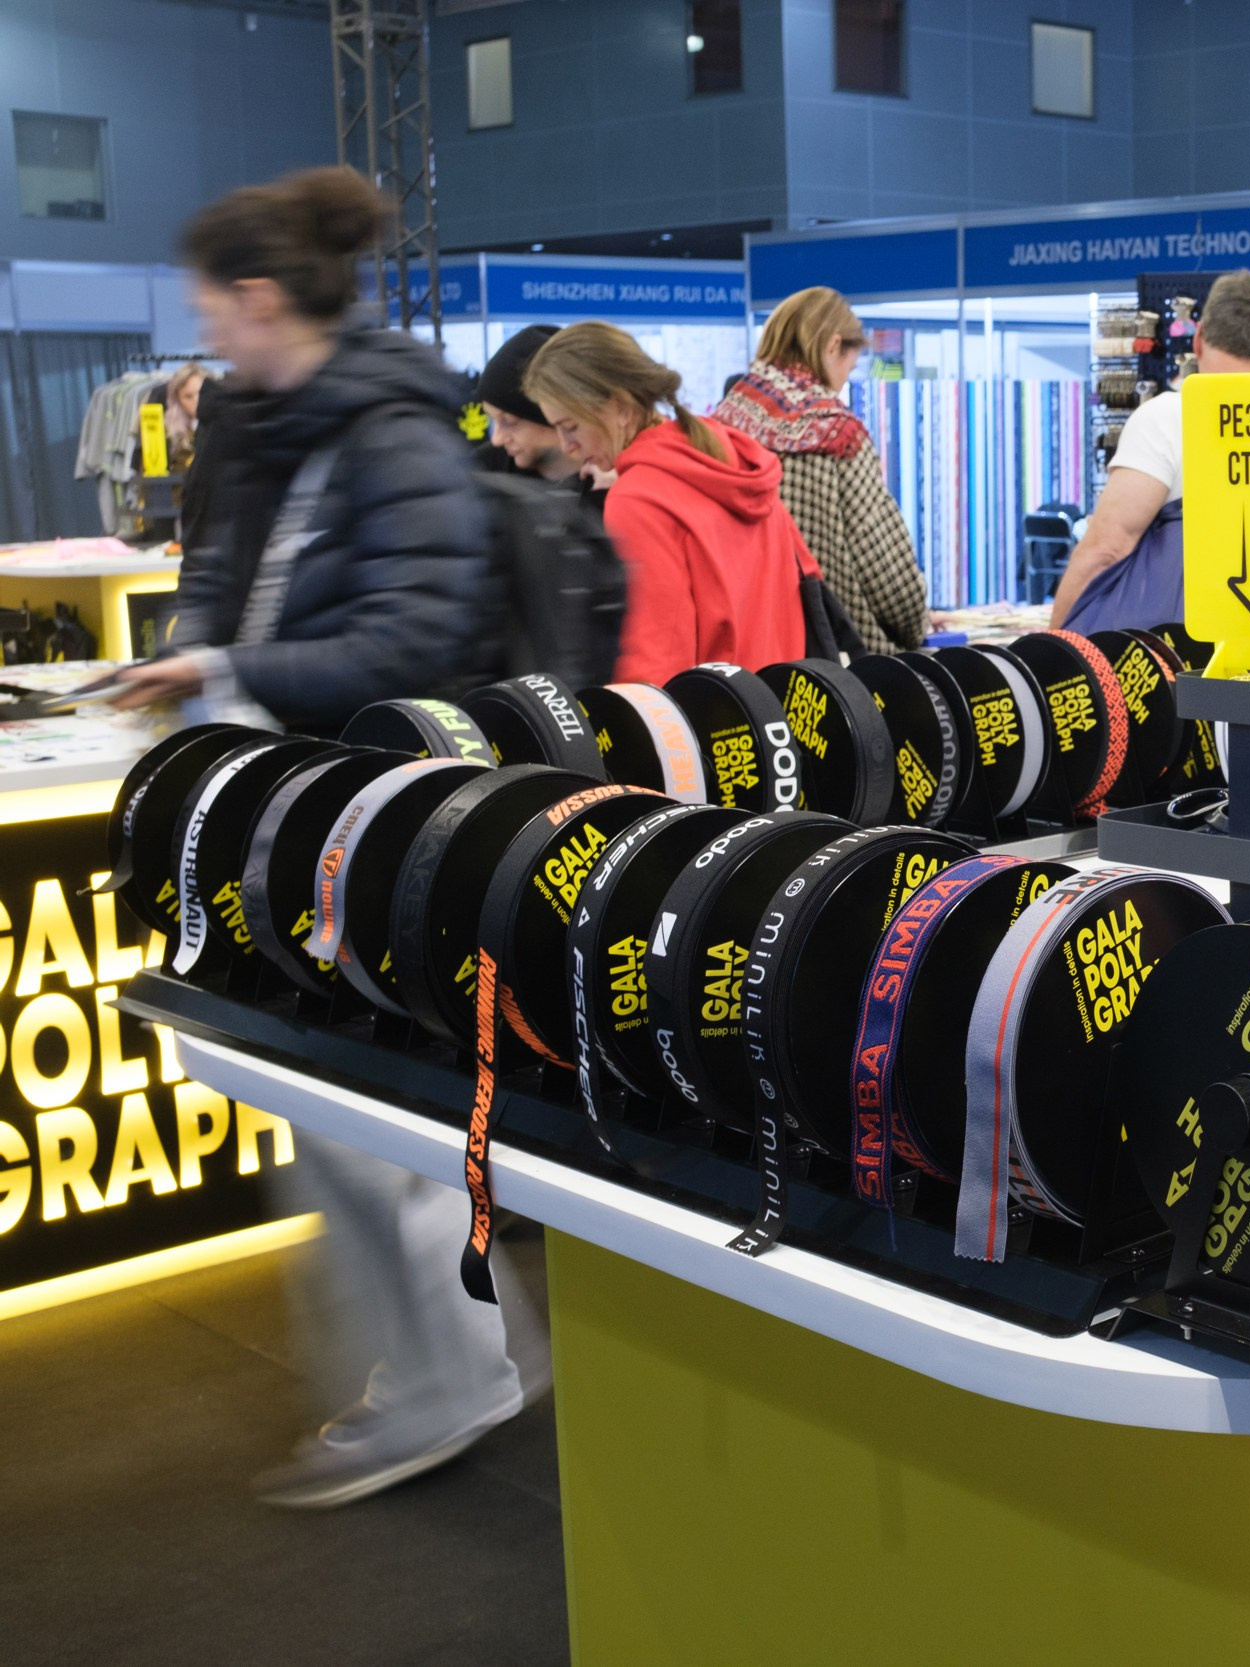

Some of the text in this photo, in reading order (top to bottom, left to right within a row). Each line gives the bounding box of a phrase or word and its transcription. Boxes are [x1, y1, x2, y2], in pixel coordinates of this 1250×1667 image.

[1009, 240, 1082, 267] JIAXING
[1087, 236, 1159, 261] HAIYAN
[521, 281, 615, 302] SHENZHEN
[619, 284, 670, 303] XIANG
[673, 285, 701, 303] RUI
[704, 286, 727, 304] DA
[795, 675, 827, 716] GALA
[1130, 648, 1160, 691] GALA
[972, 704, 997, 766] GRAPH
[986, 701, 1006, 746] POLY
[1000, 697, 1019, 747] GALA
[1049, 692, 1075, 753] GRAPH
[1061, 687, 1083, 732] POLY
[1076, 683, 1097, 733] GALA
[738, 734, 760, 790] GALA
[546, 784, 624, 826] RUSSIA
[544, 822, 607, 887] GALA
[695, 817, 774, 868] bodo
[892, 852, 905, 886] details
[1016, 870, 1030, 905] details
[0, 870, 168, 999] AL
[873, 878, 969, 1003] SIMBA
[1063, 941, 1077, 977] details
[1077, 899, 1144, 965] GALA
[608, 935, 639, 1016] GALA
[701, 940, 734, 1022] GALA
[1083, 932, 1142, 1001] POLY
[477, 946, 497, 1064] RUNNING
[1072, 988, 1094, 1043] inspiration
[1094, 962, 1153, 1032] GRA
[573, 947, 598, 1122] FISCHER
[657, 1028, 699, 1102] bodo
[469, 1057, 495, 1162] HEROES
[857, 1043, 889, 1201] SIMBA
